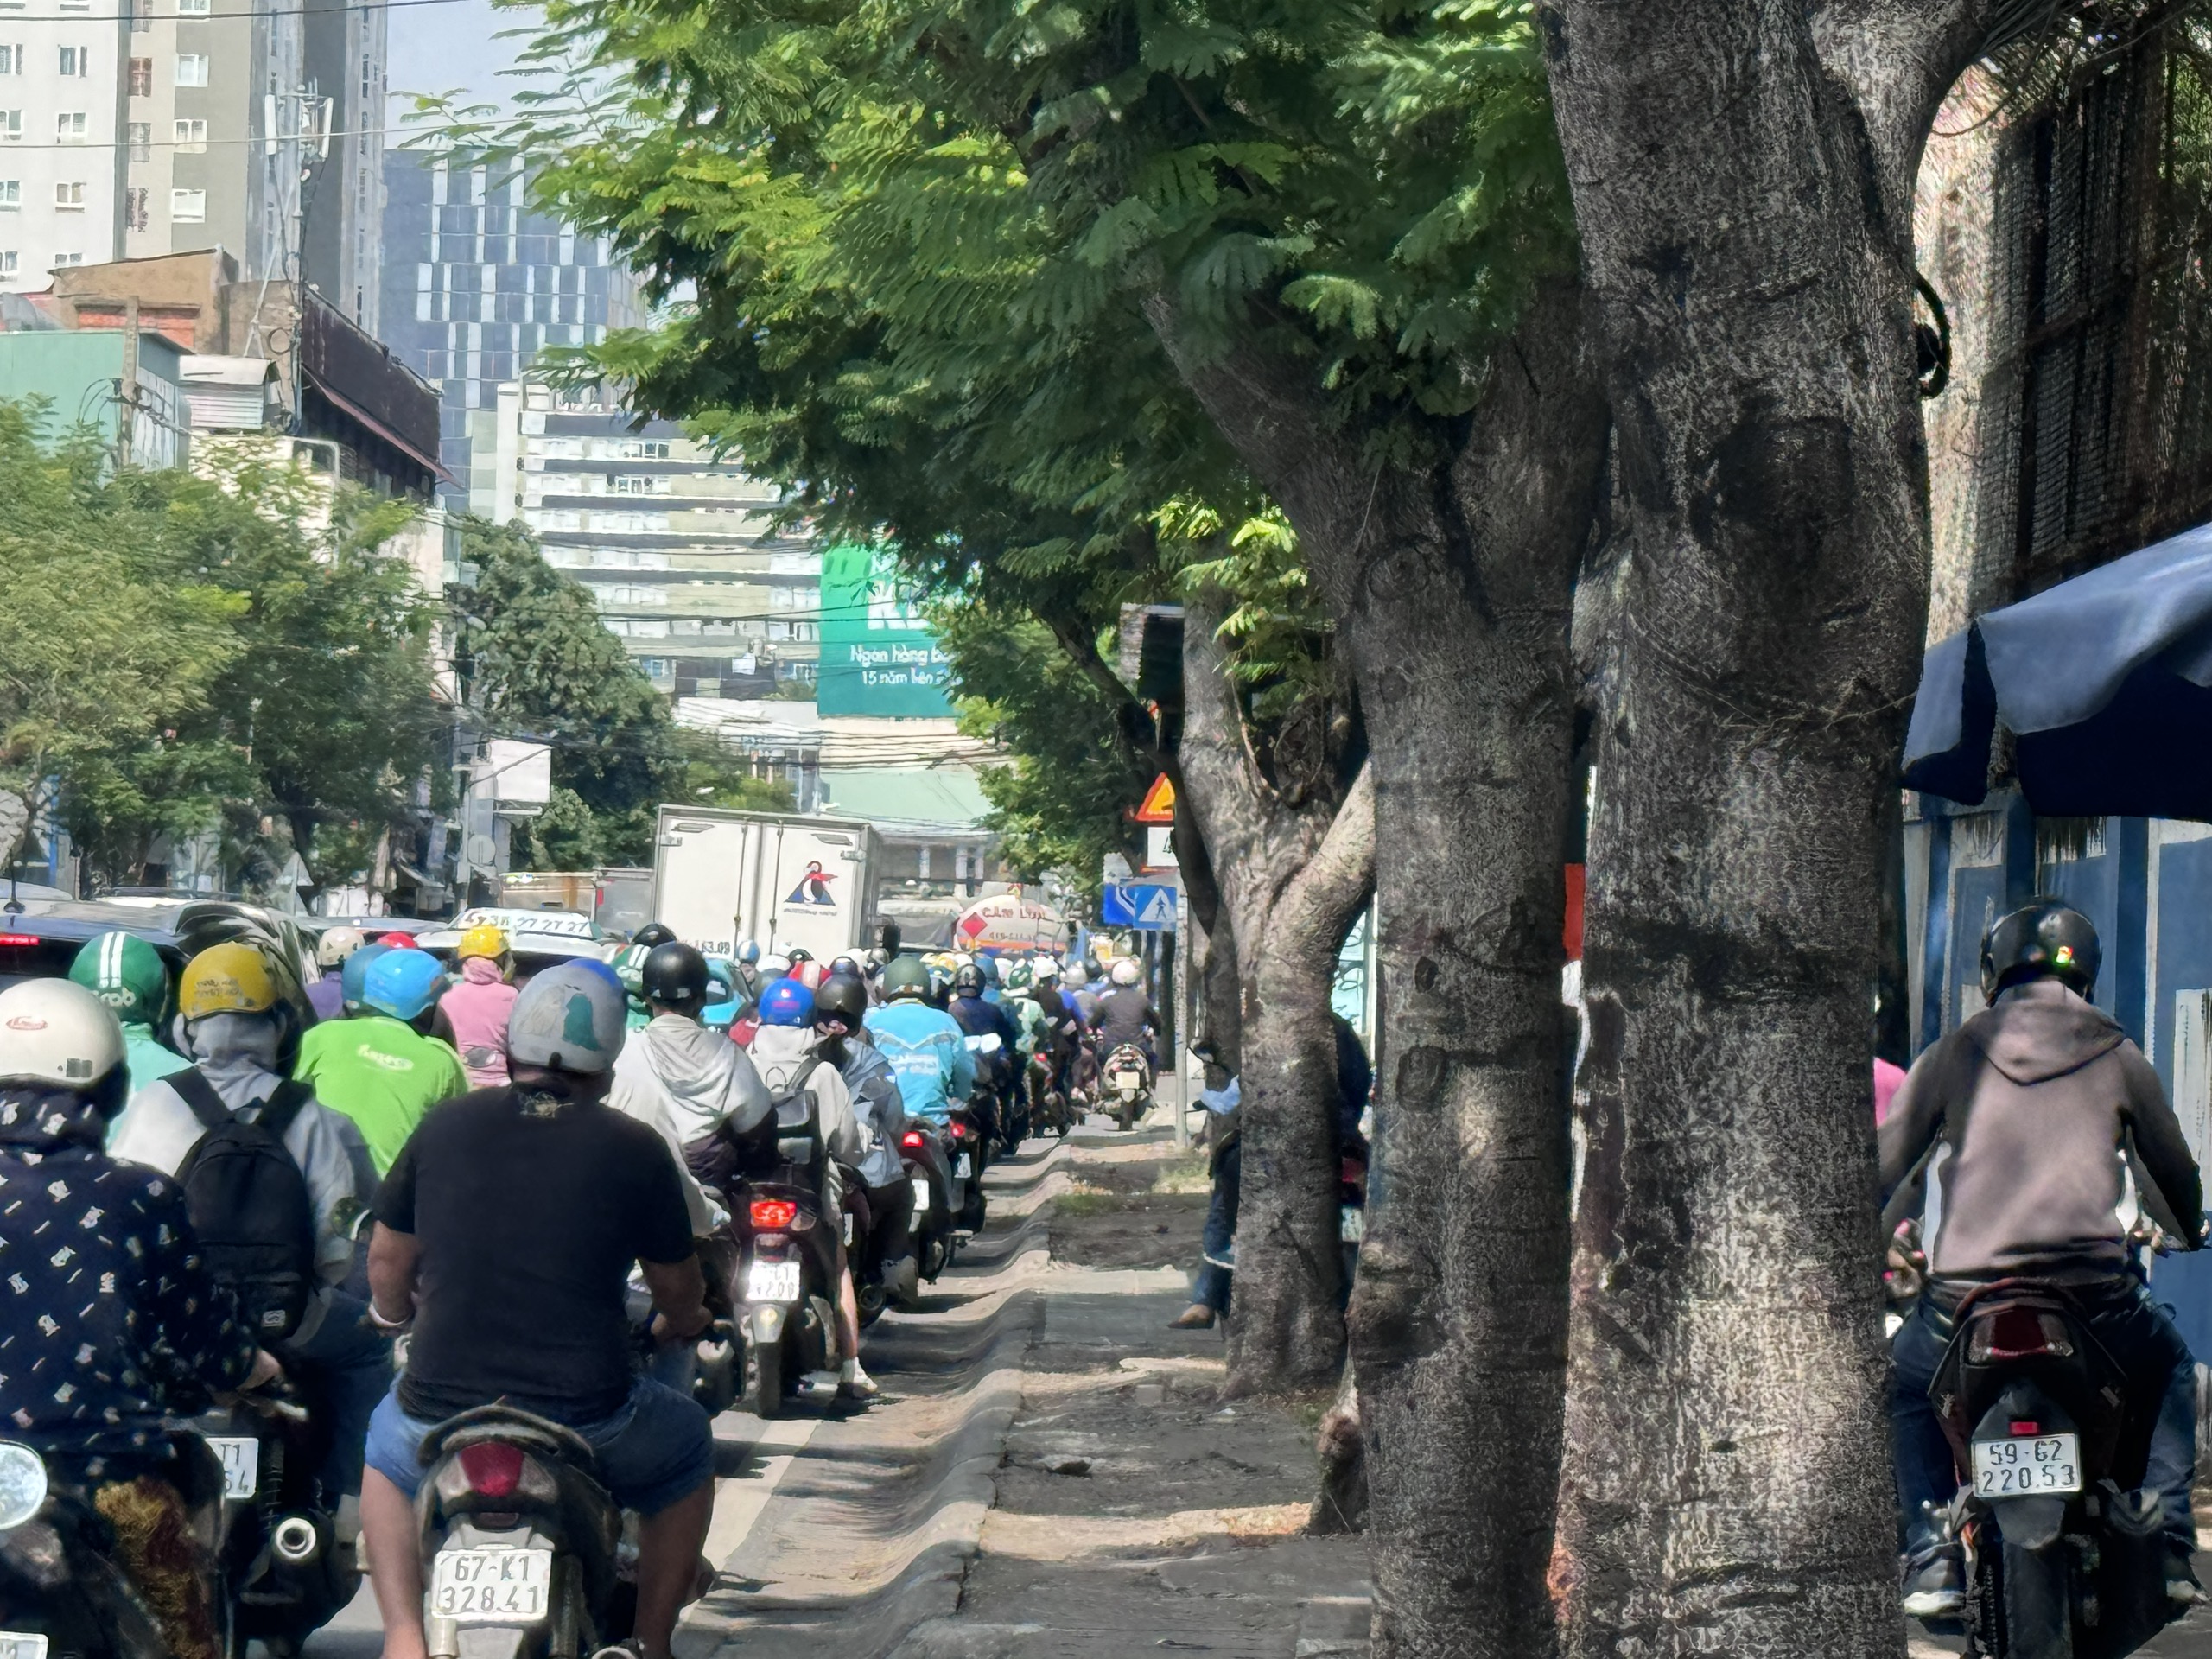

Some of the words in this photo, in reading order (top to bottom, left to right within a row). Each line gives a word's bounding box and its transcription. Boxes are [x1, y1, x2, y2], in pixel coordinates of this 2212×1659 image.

[862, 671, 877, 685] 15
[92, 987, 137, 1007] rab
[1989, 1440, 2063, 1465] 59-G2
[1982, 1465, 2075, 1492] 220.53
[454, 1556, 530, 1581] 67-K1
[441, 1586, 538, 1613] 328.41
